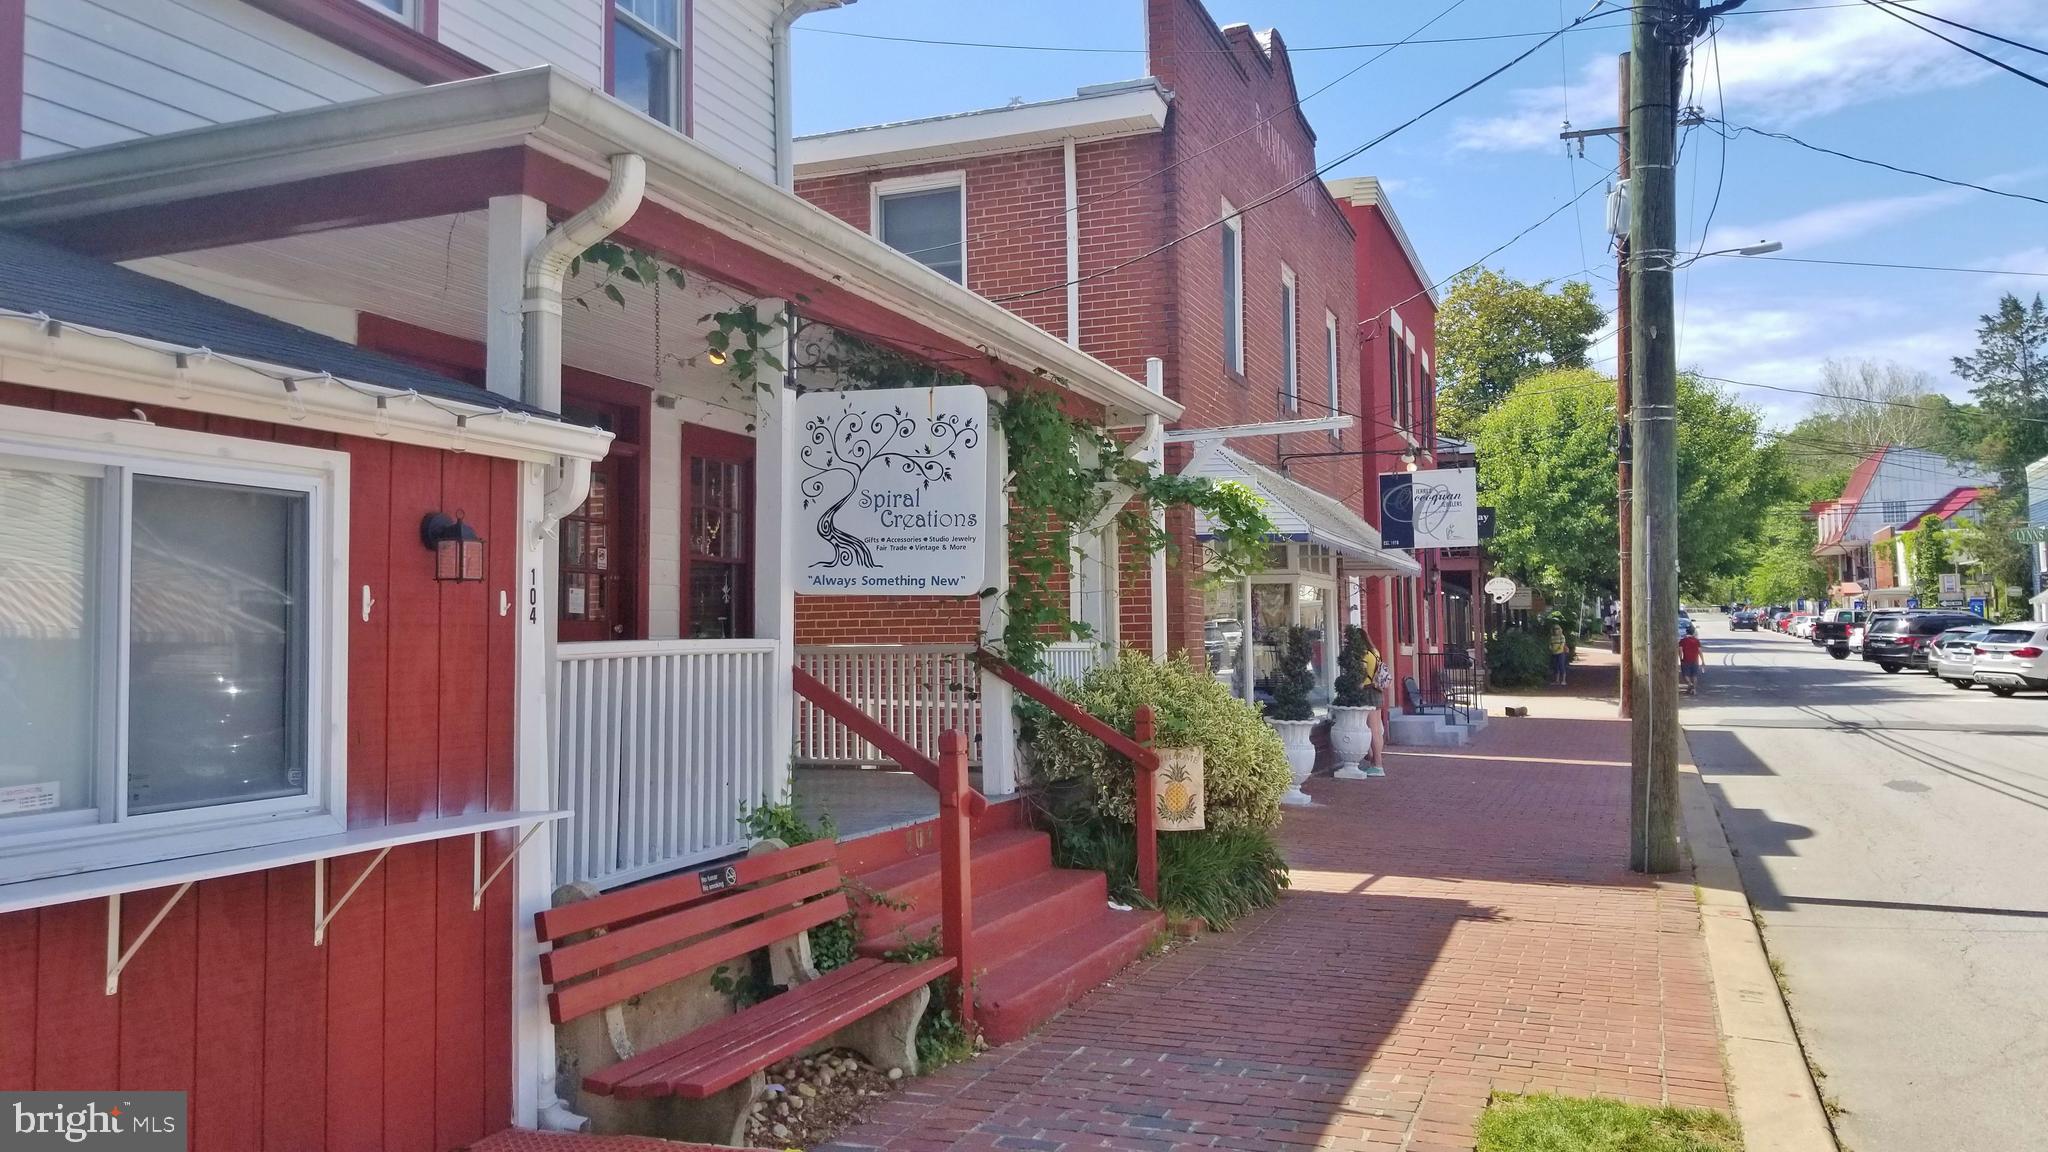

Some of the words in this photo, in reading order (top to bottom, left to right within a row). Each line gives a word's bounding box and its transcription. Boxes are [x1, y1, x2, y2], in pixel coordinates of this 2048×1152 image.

[858, 487, 920, 513] Spiral
[880, 509, 978, 531] Creations
[952, 535, 977, 543] Jewelry
[915, 544, 940, 552] Vintage
[808, 575, 857, 588] "Always
[861, 575, 926, 588] Something
[931, 575, 966, 586] New"
[529, 568, 537, 625] 104
